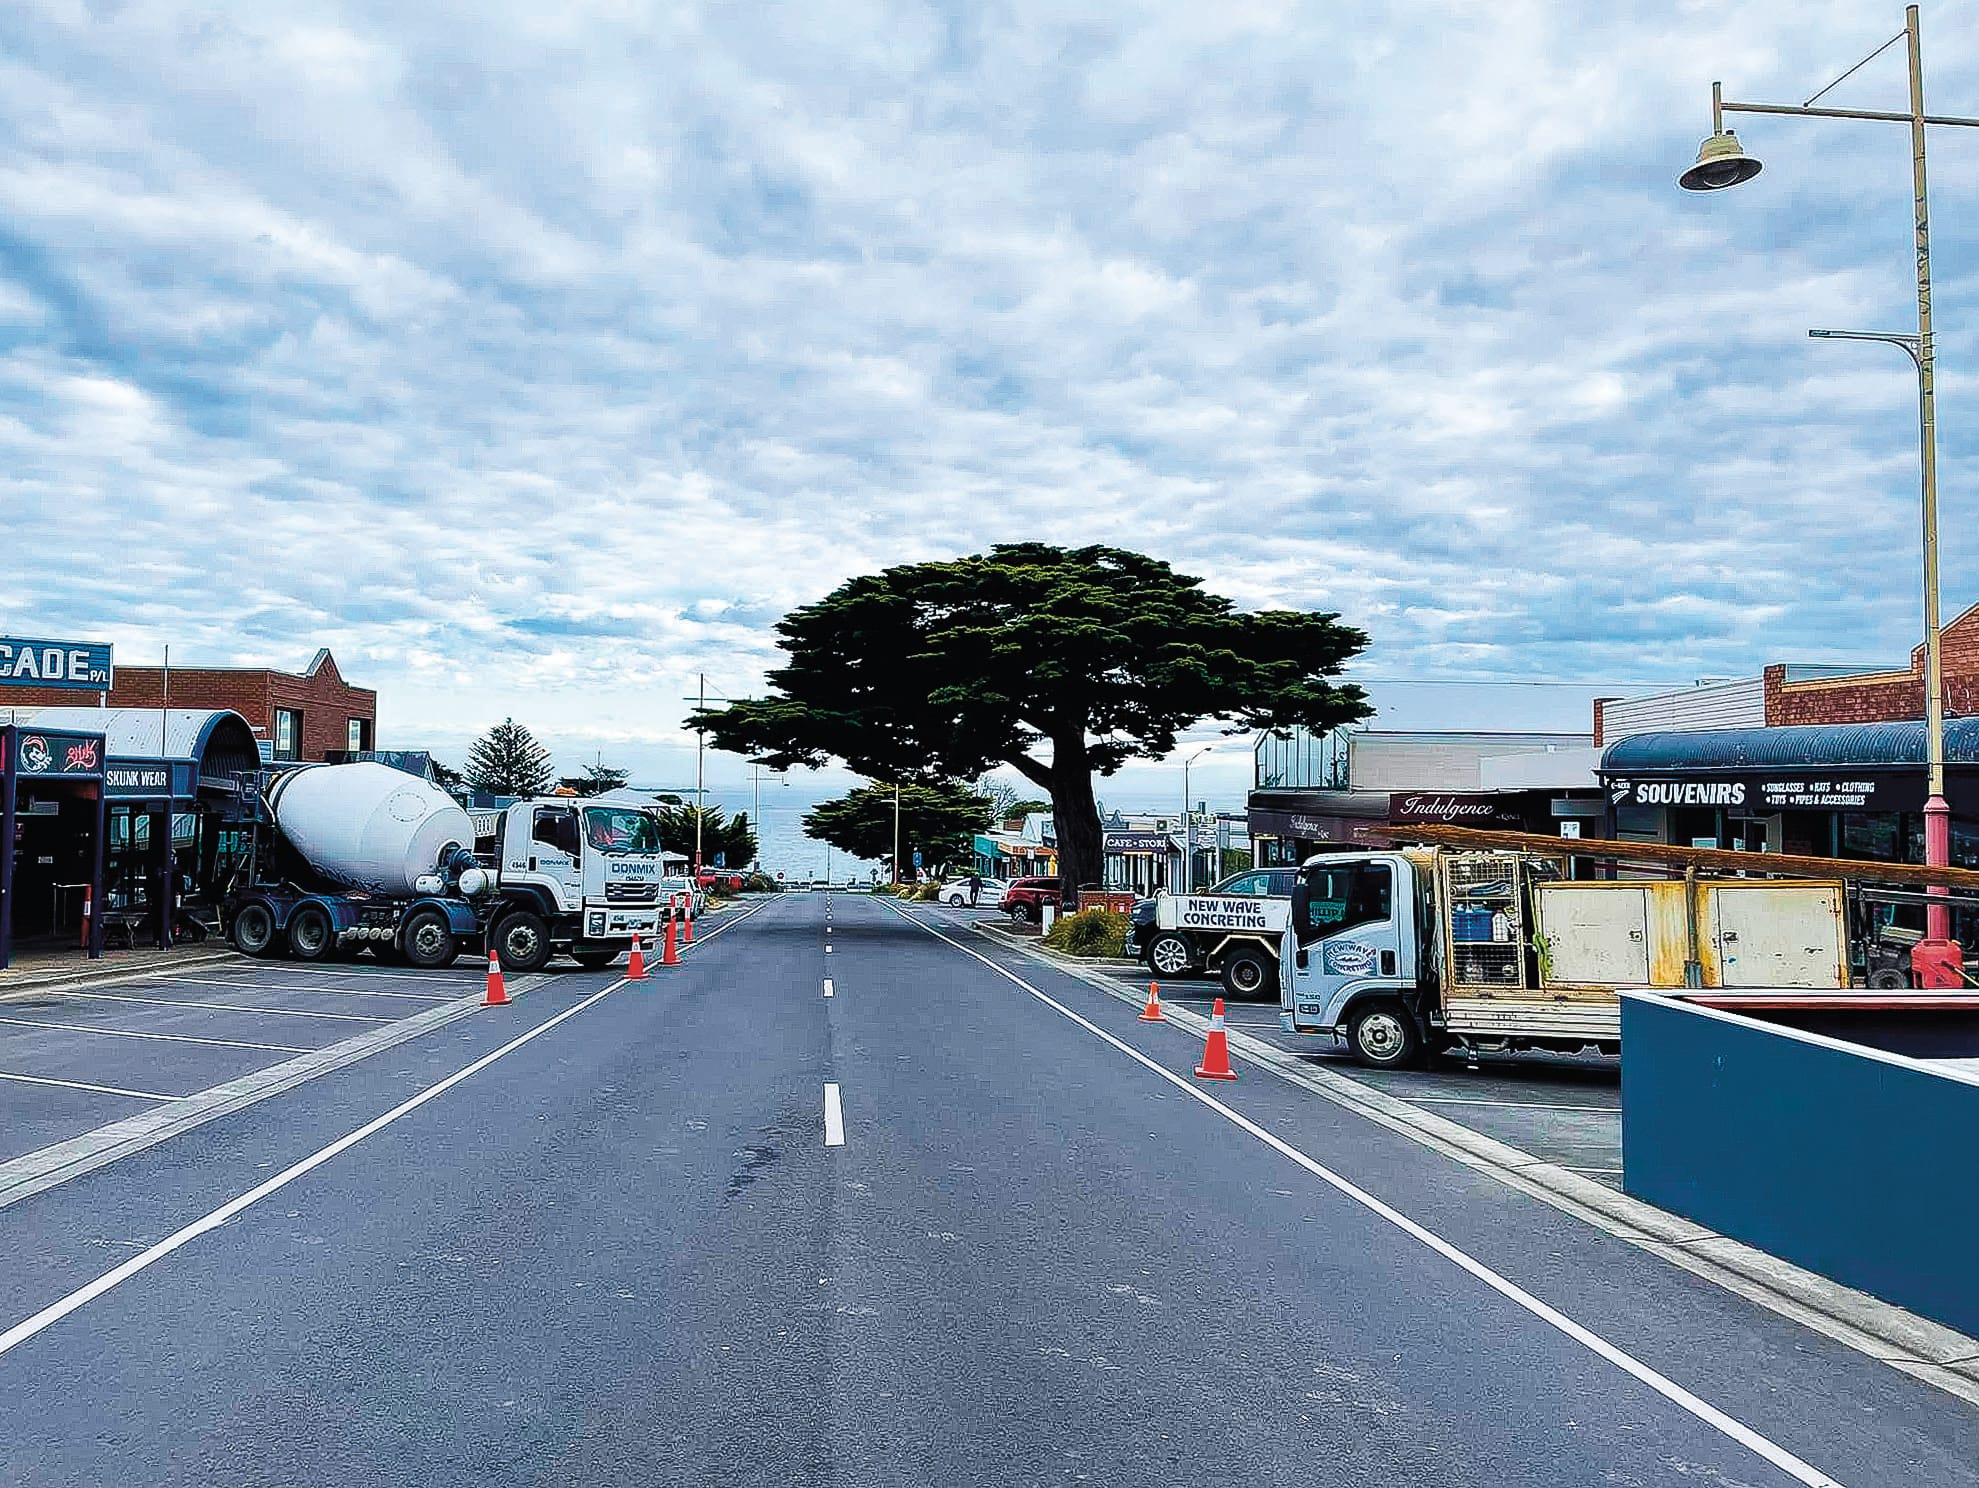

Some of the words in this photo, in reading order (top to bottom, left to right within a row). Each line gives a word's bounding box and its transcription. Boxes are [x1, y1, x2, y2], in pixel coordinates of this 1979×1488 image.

[107, 770, 139, 786] SKUNK
[140, 771, 167, 786] WEAR
[1636, 782, 1746, 804] SOUVENIRS
[1766, 782, 1805, 793] SUNGLASSES
[1814, 782, 1831, 793] HATS
[1841, 782, 1875, 793] CLOTHING
[1771, 795, 1787, 805] TOYS
[1795, 795, 1814, 805] PIPES
[1820, 795, 1866, 806] ACCESSORIES
[1400, 796, 1494, 821] Indulgence
[1107, 838, 1132, 848] CAFE
[611, 863, 656, 874] DONMIX
[1188, 899, 1219, 912] NEW
[1222, 900, 1262, 914] WAVE
[1183, 912, 1266, 928] CONCRETING
